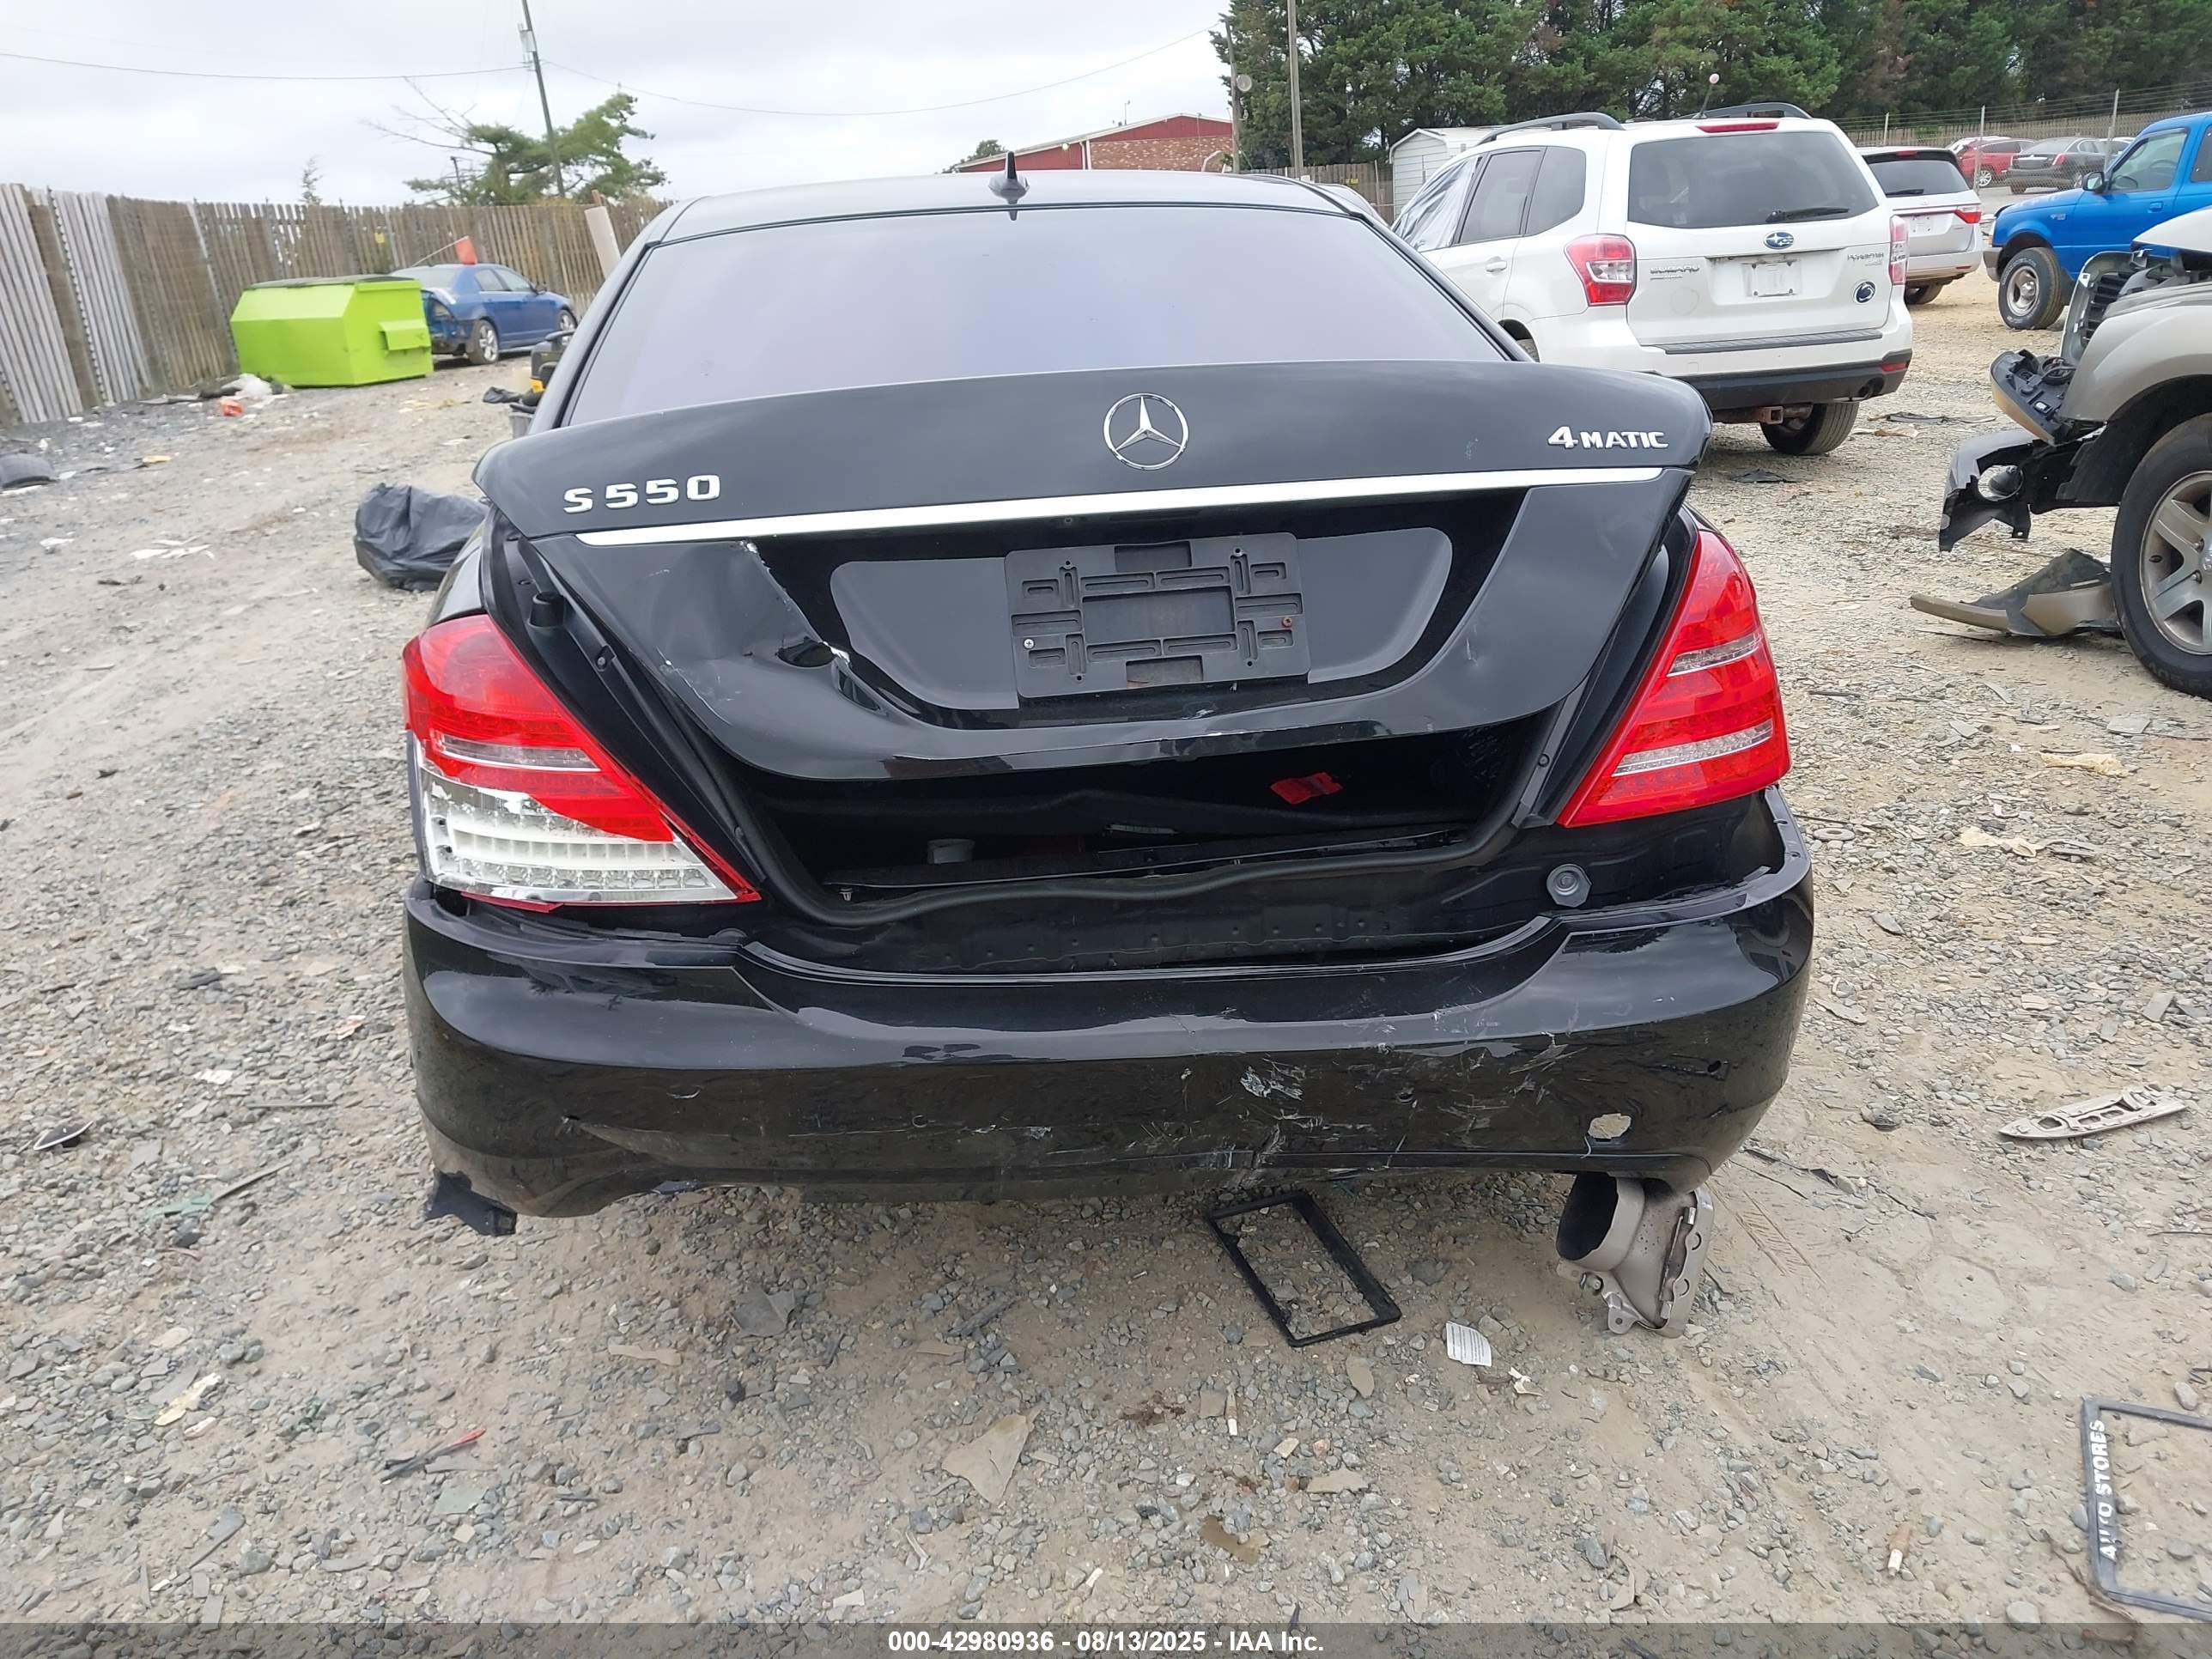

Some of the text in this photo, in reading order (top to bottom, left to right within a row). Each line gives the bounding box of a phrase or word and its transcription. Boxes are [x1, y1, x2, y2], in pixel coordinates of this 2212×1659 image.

[562, 474, 720, 514] S 550
[2089, 1419, 2112, 1496] STORES
